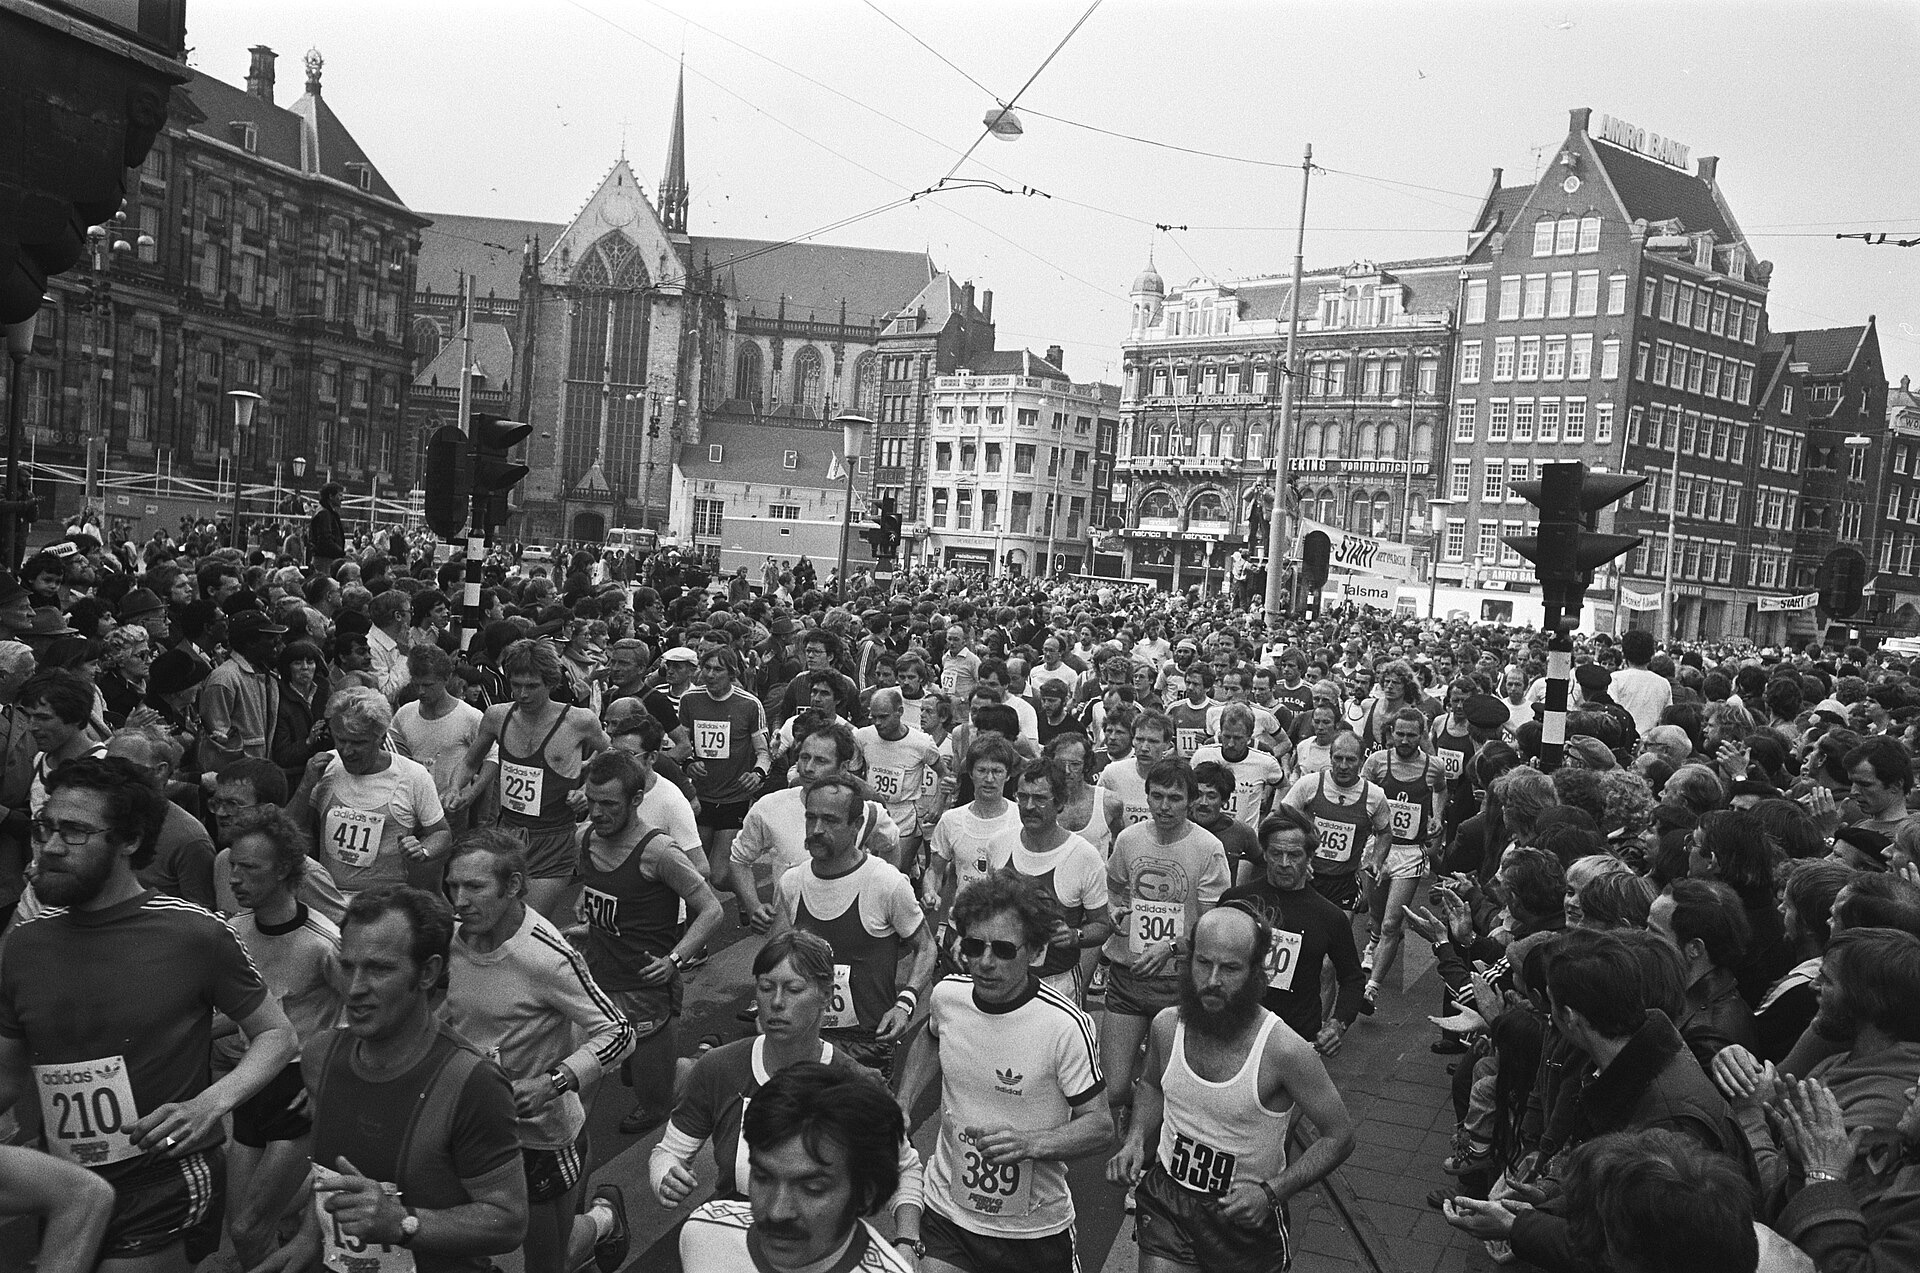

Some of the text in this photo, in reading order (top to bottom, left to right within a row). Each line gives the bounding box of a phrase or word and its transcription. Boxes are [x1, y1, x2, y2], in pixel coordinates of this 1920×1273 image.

[1600, 114, 1690, 170] AMRO BANK
[1906, 418, 1920, 428] WO
[1263, 458, 1429, 474] WOTERING woninginriching
[1335, 534, 1380, 568] START
[1492, 570, 1517, 580] AMRO
[1342, 583, 1388, 599] Talsma
[1781, 597, 1804, 608] START
[1284, 696, 1306, 708] KLOK
[700, 731, 725, 749] 179
[505, 775, 536, 802] 225
[874, 775, 898, 795] 395
[333, 808, 367, 823] adidas
[1126, 804, 1148, 813] adida
[1393, 811, 1412, 829] 63
[333, 822, 371, 853] 411
[1320, 830, 1348, 851] 463
[1135, 904, 1167, 914] adidas
[1138, 915, 1176, 941] 304
[42, 1068, 93, 1085] adidas
[995, 1085, 1023, 1096] adidas
[53, 1087, 122, 1139] 210
[962, 1151, 1020, 1197] 389
[1170, 1132, 1235, 1198] 539
